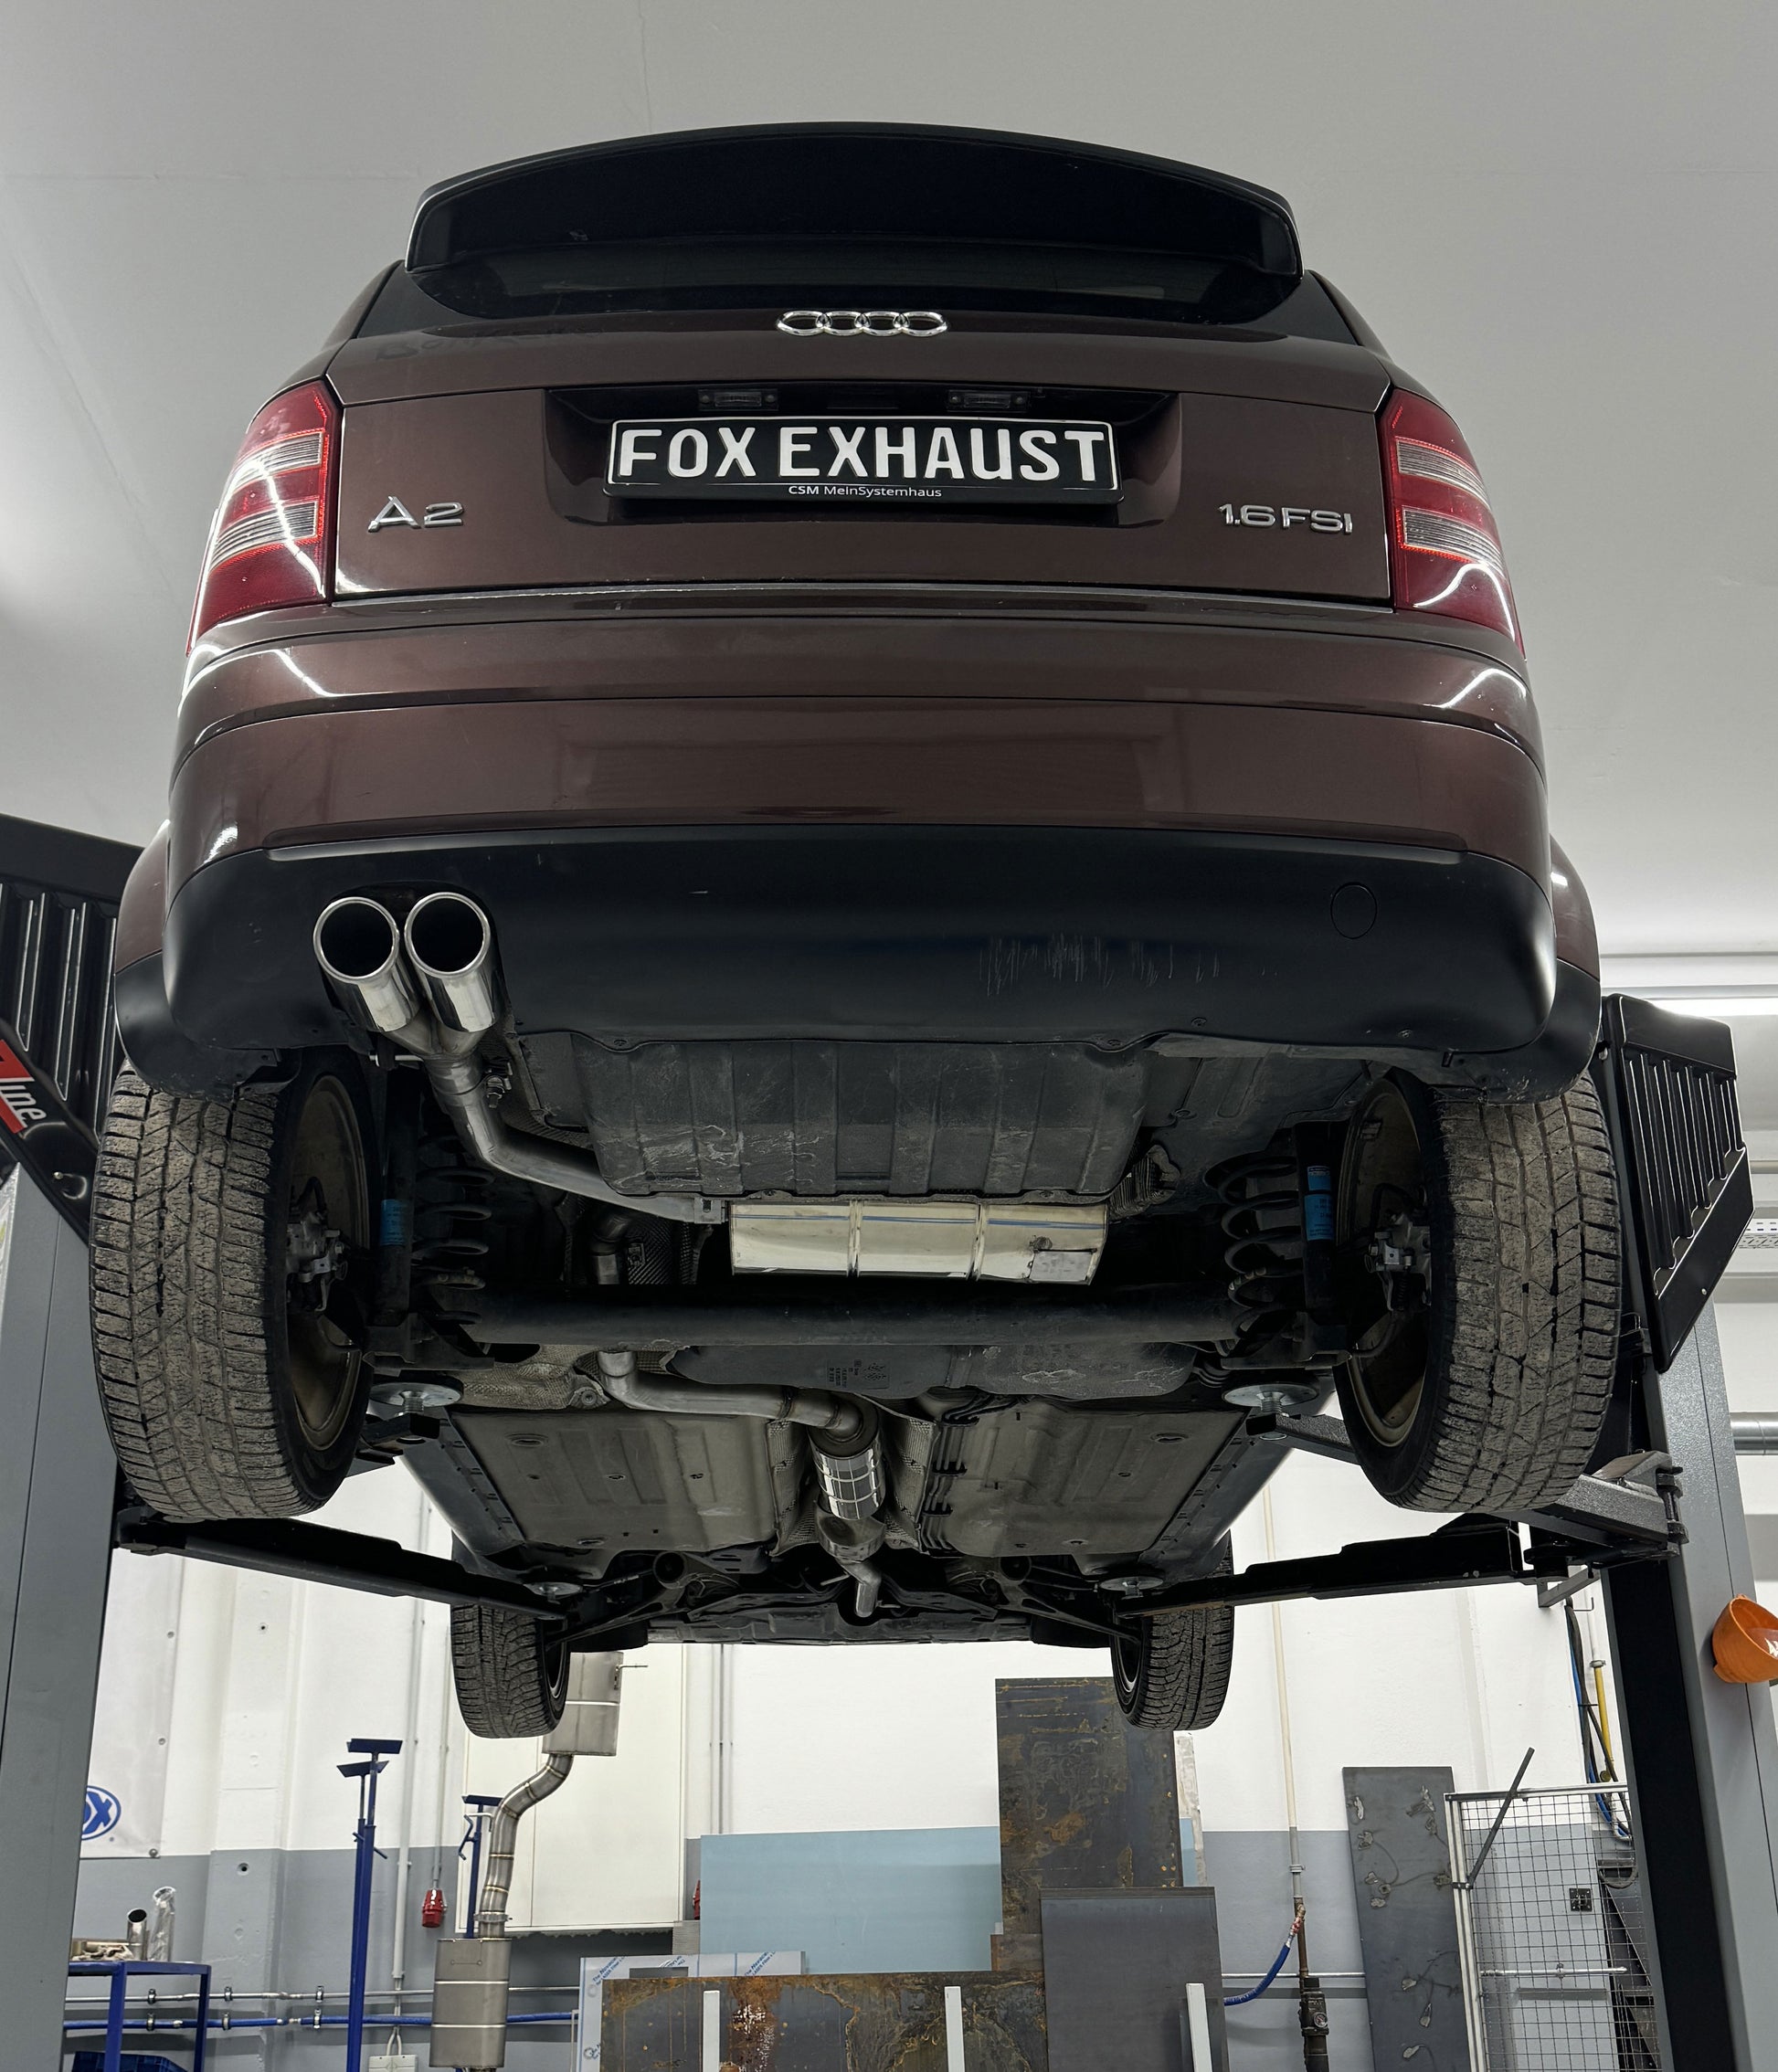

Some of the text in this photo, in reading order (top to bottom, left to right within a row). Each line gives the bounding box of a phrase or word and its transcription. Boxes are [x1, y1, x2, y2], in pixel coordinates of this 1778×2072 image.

[618, 427, 1105, 481] FOX EXHAUST
[788, 486, 942, 498] CSM MeinSystemhaus
[368, 496, 463, 532] A2
[1281, 507, 1353, 534] FSI
